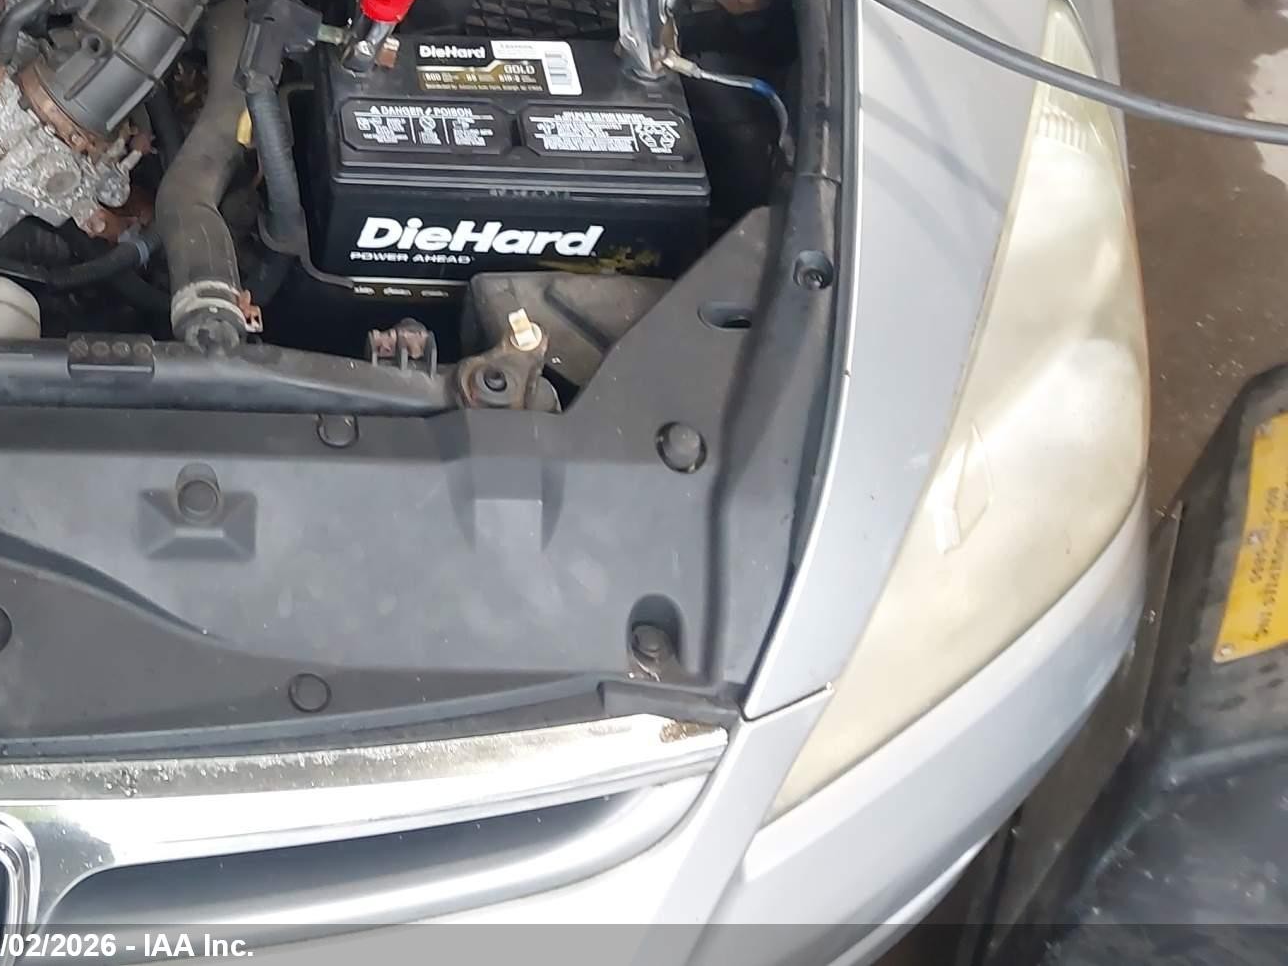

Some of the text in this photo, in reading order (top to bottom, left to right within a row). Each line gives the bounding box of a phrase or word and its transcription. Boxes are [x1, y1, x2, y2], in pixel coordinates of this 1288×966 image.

[419, 44, 486, 59] DieHard
[503, 64, 536, 75] GOLD
[380, 105, 424, 116] DANGER
[433, 107, 473, 118] POISON
[356, 216, 605, 256] DieHard
[350, 251, 471, 264] POWER AHEAD
